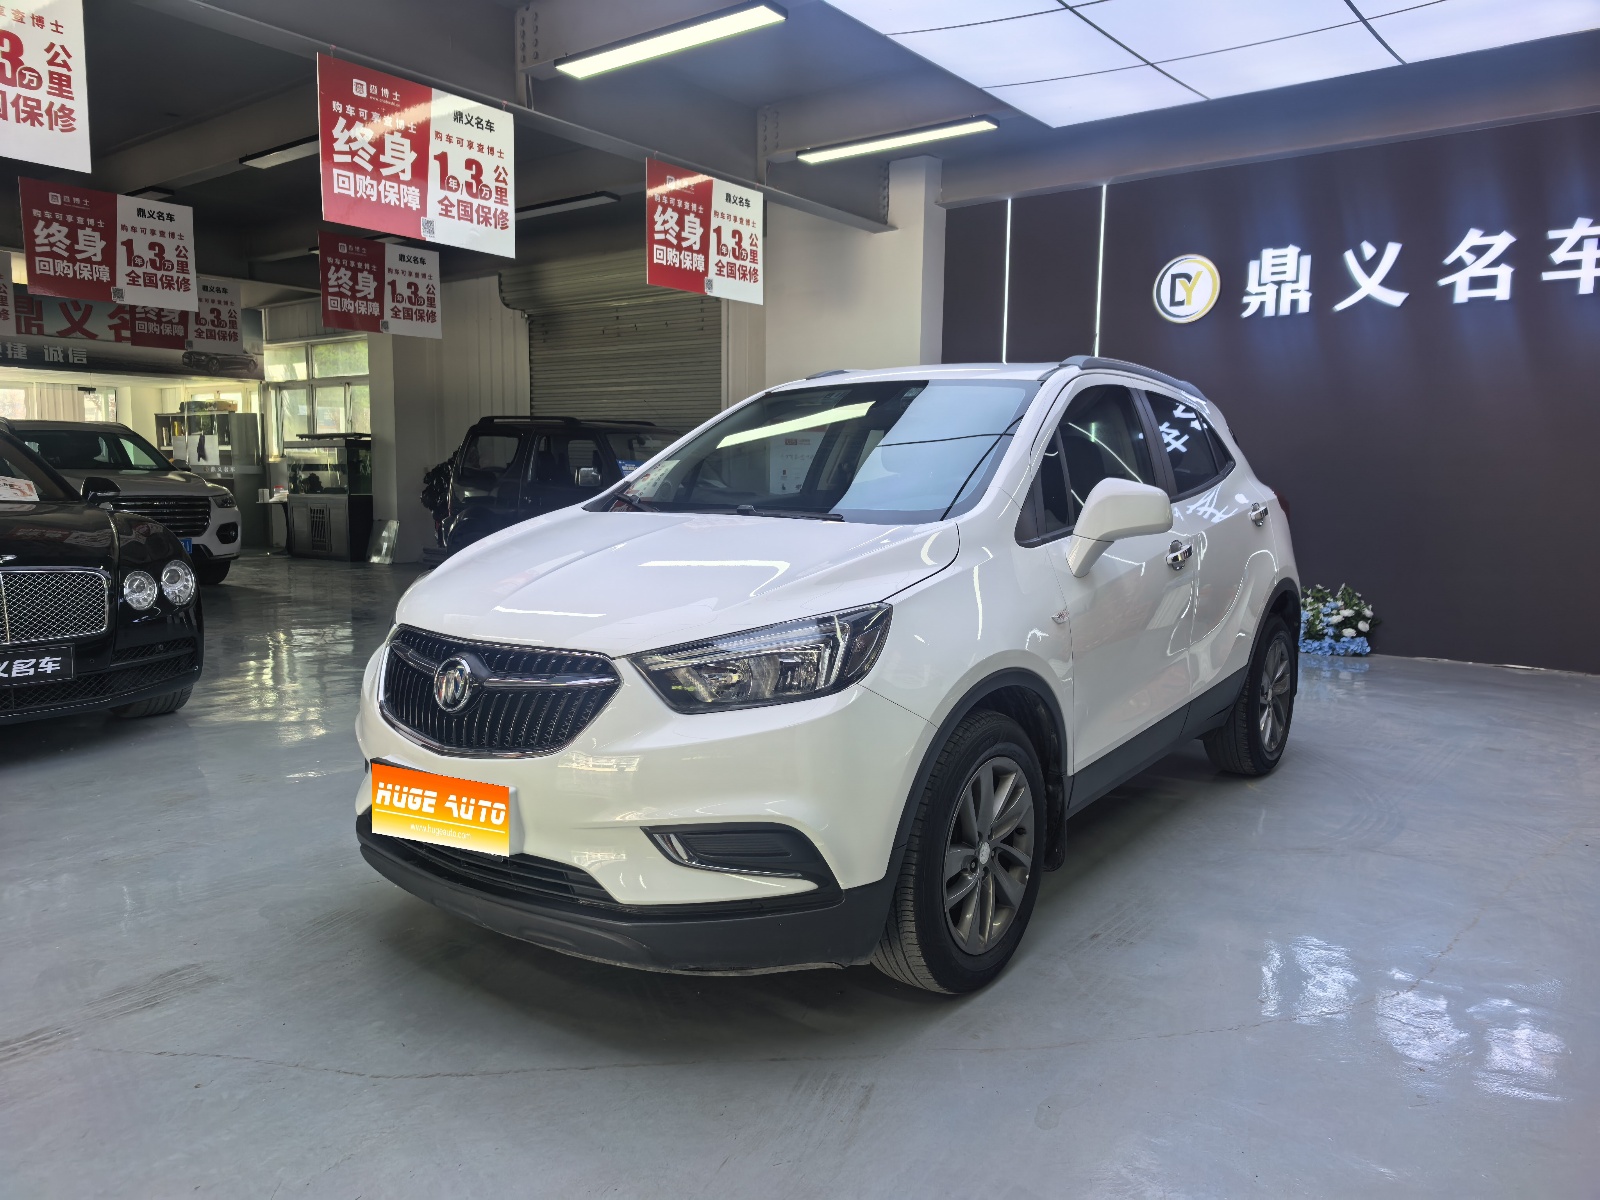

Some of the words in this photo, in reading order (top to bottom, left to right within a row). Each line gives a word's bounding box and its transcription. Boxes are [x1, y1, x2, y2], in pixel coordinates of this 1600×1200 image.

[0, 90, 77, 133] 保修
[453, 110, 496, 133] 鼎义名车
[332, 116, 418, 182] 终身
[434, 130, 505, 160] 购车可享查博士
[332, 168, 421, 211] 回购保障
[725, 192, 751, 209] 鼎义名车
[32, 209, 105, 228] 购车可享查博士
[136, 207, 176, 223] 鼎义名车
[437, 195, 510, 231] 全国保修
[713, 210, 757, 229] 购车可享查博士
[120, 223, 185, 241] 购车可享查博士
[653, 205, 704, 250] 终身
[33, 220, 107, 262] 终身
[35, 256, 111, 283] 回购保障
[398, 253, 427, 266] 鼎义名车
[653, 244, 706, 273] 回购保障
[1240, 216, 1600, 319] 鼎义名车
[125, 270, 192, 292] 全国保修
[327, 265, 378, 299] 终身
[715, 260, 760, 283] 全国保修
[327, 296, 381, 317] 回购保障
[390, 305, 437, 323] 全国保修
[135, 321, 185, 337] 回购保障
[194, 327, 239, 342] 全国保修
[43, 344, 88, 364] 诚信
